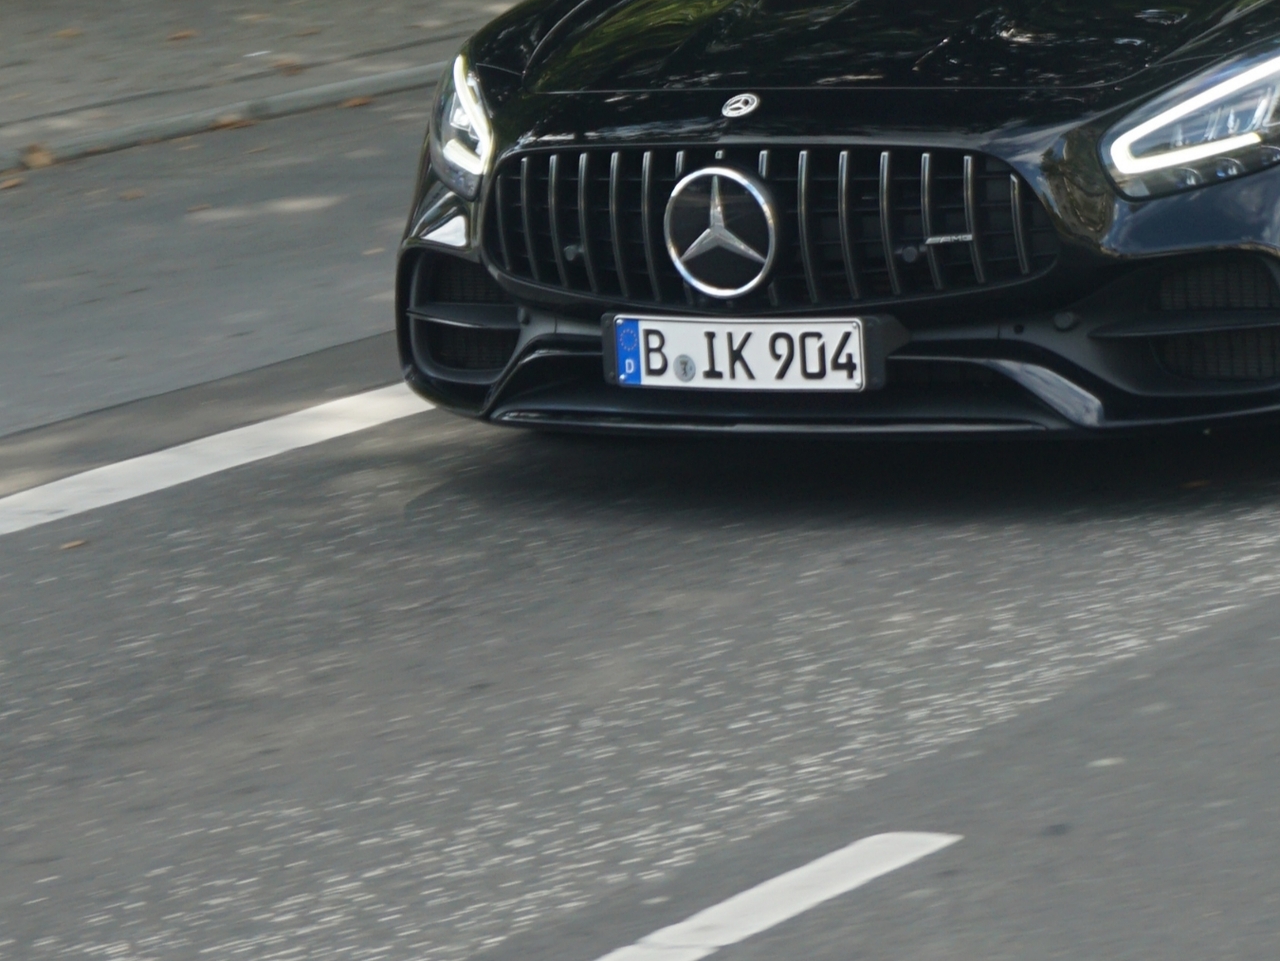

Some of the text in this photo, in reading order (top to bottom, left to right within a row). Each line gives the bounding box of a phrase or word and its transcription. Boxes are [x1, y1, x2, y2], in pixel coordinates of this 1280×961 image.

[625, 358, 635, 374] D
[642, 328, 857, 380] B IK 904
